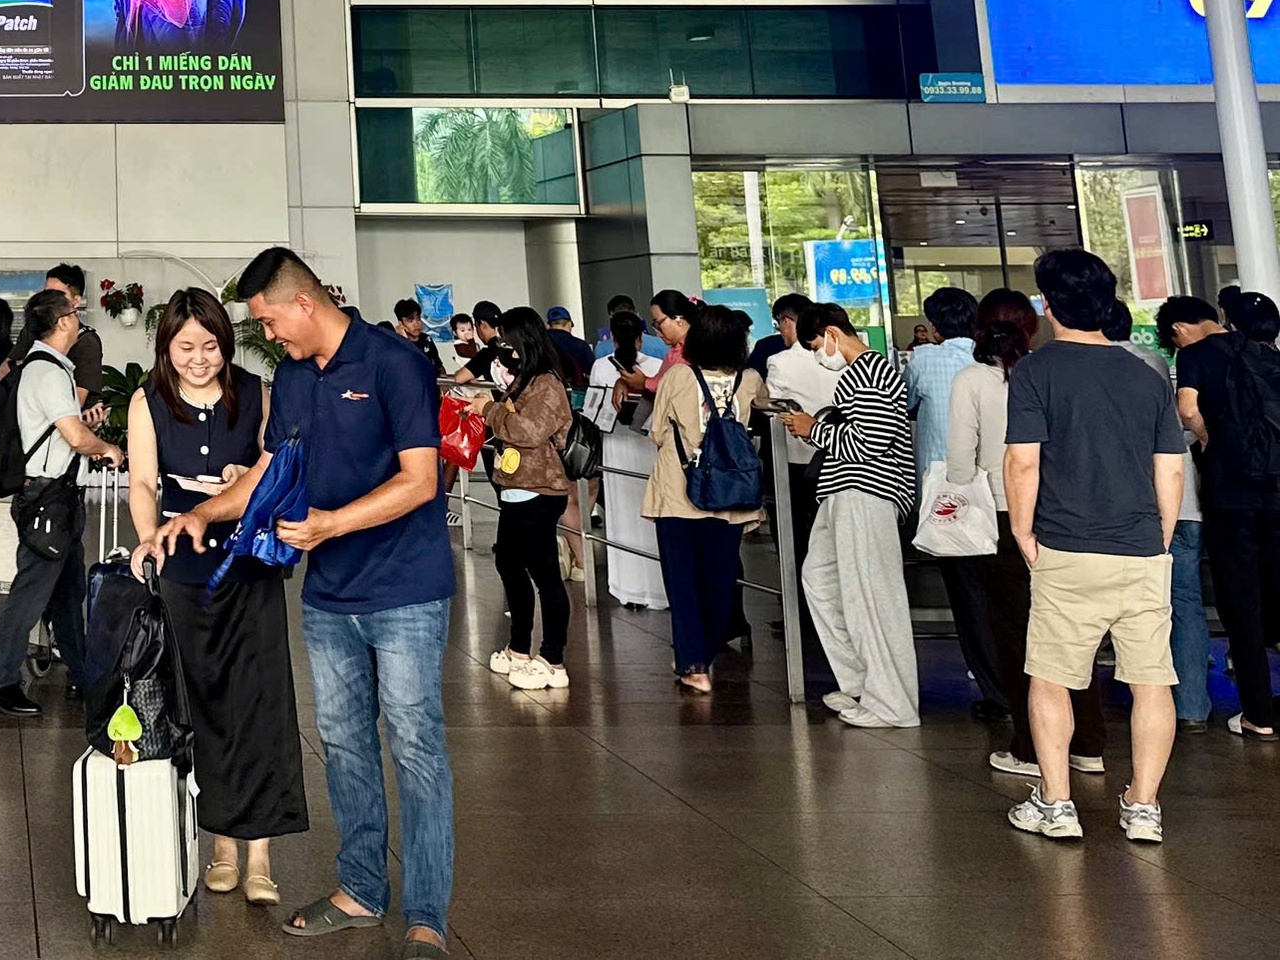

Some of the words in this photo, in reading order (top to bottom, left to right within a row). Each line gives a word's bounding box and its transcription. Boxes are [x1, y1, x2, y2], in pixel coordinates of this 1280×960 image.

[111, 51, 140, 71] CHỈ
[145, 56, 153, 71] 1
[159, 51, 212, 71] MIẾNG
[218, 52, 252, 71] DÁN
[89, 71, 134, 90] GIẢM
[140, 74, 174, 90] ĐAU
[179, 74, 224, 92] TRỌN
[230, 72, 276, 90] NGÀY
